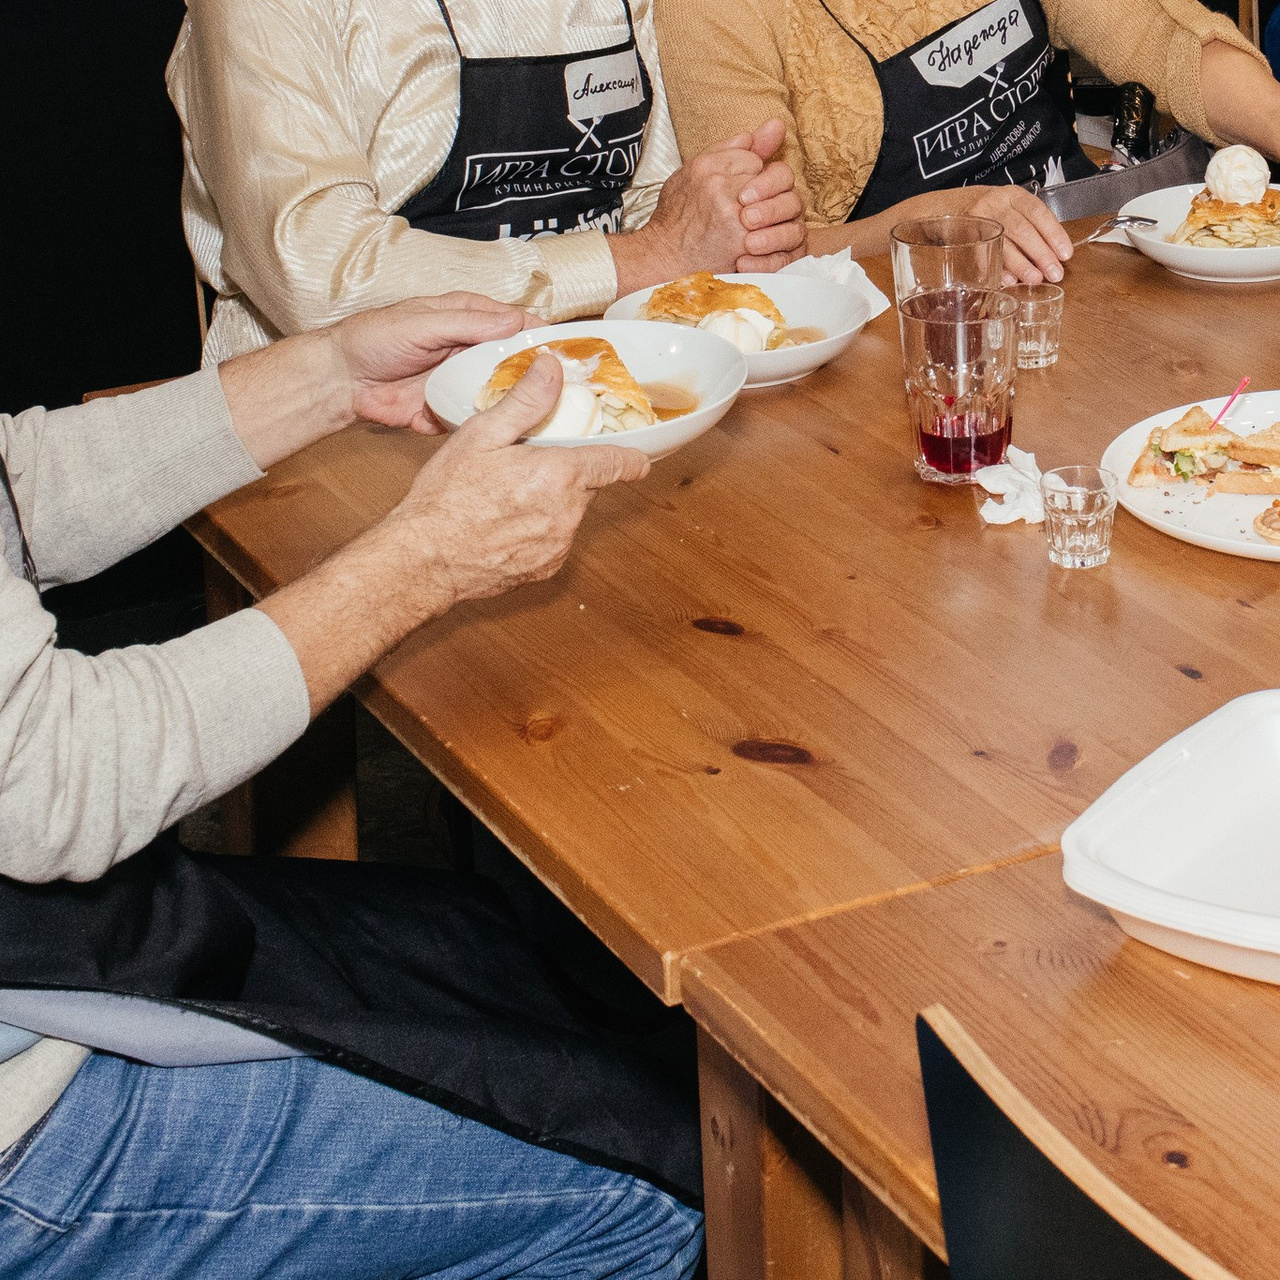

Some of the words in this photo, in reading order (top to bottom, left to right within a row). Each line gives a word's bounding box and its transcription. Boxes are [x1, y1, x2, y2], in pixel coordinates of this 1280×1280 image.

[927, 8, 1019, 72] Надежда
[921, 111, 993, 159] ИГРА
[953, 131, 995, 159] КУЛИН
[989, 120, 1027, 163] ШЕФ-ПОВАР
[1020, 120, 1042, 149] ВИКТОР
[469, 159, 550, 190] ИГРА
[560, 138, 643, 177] СТОЛ
